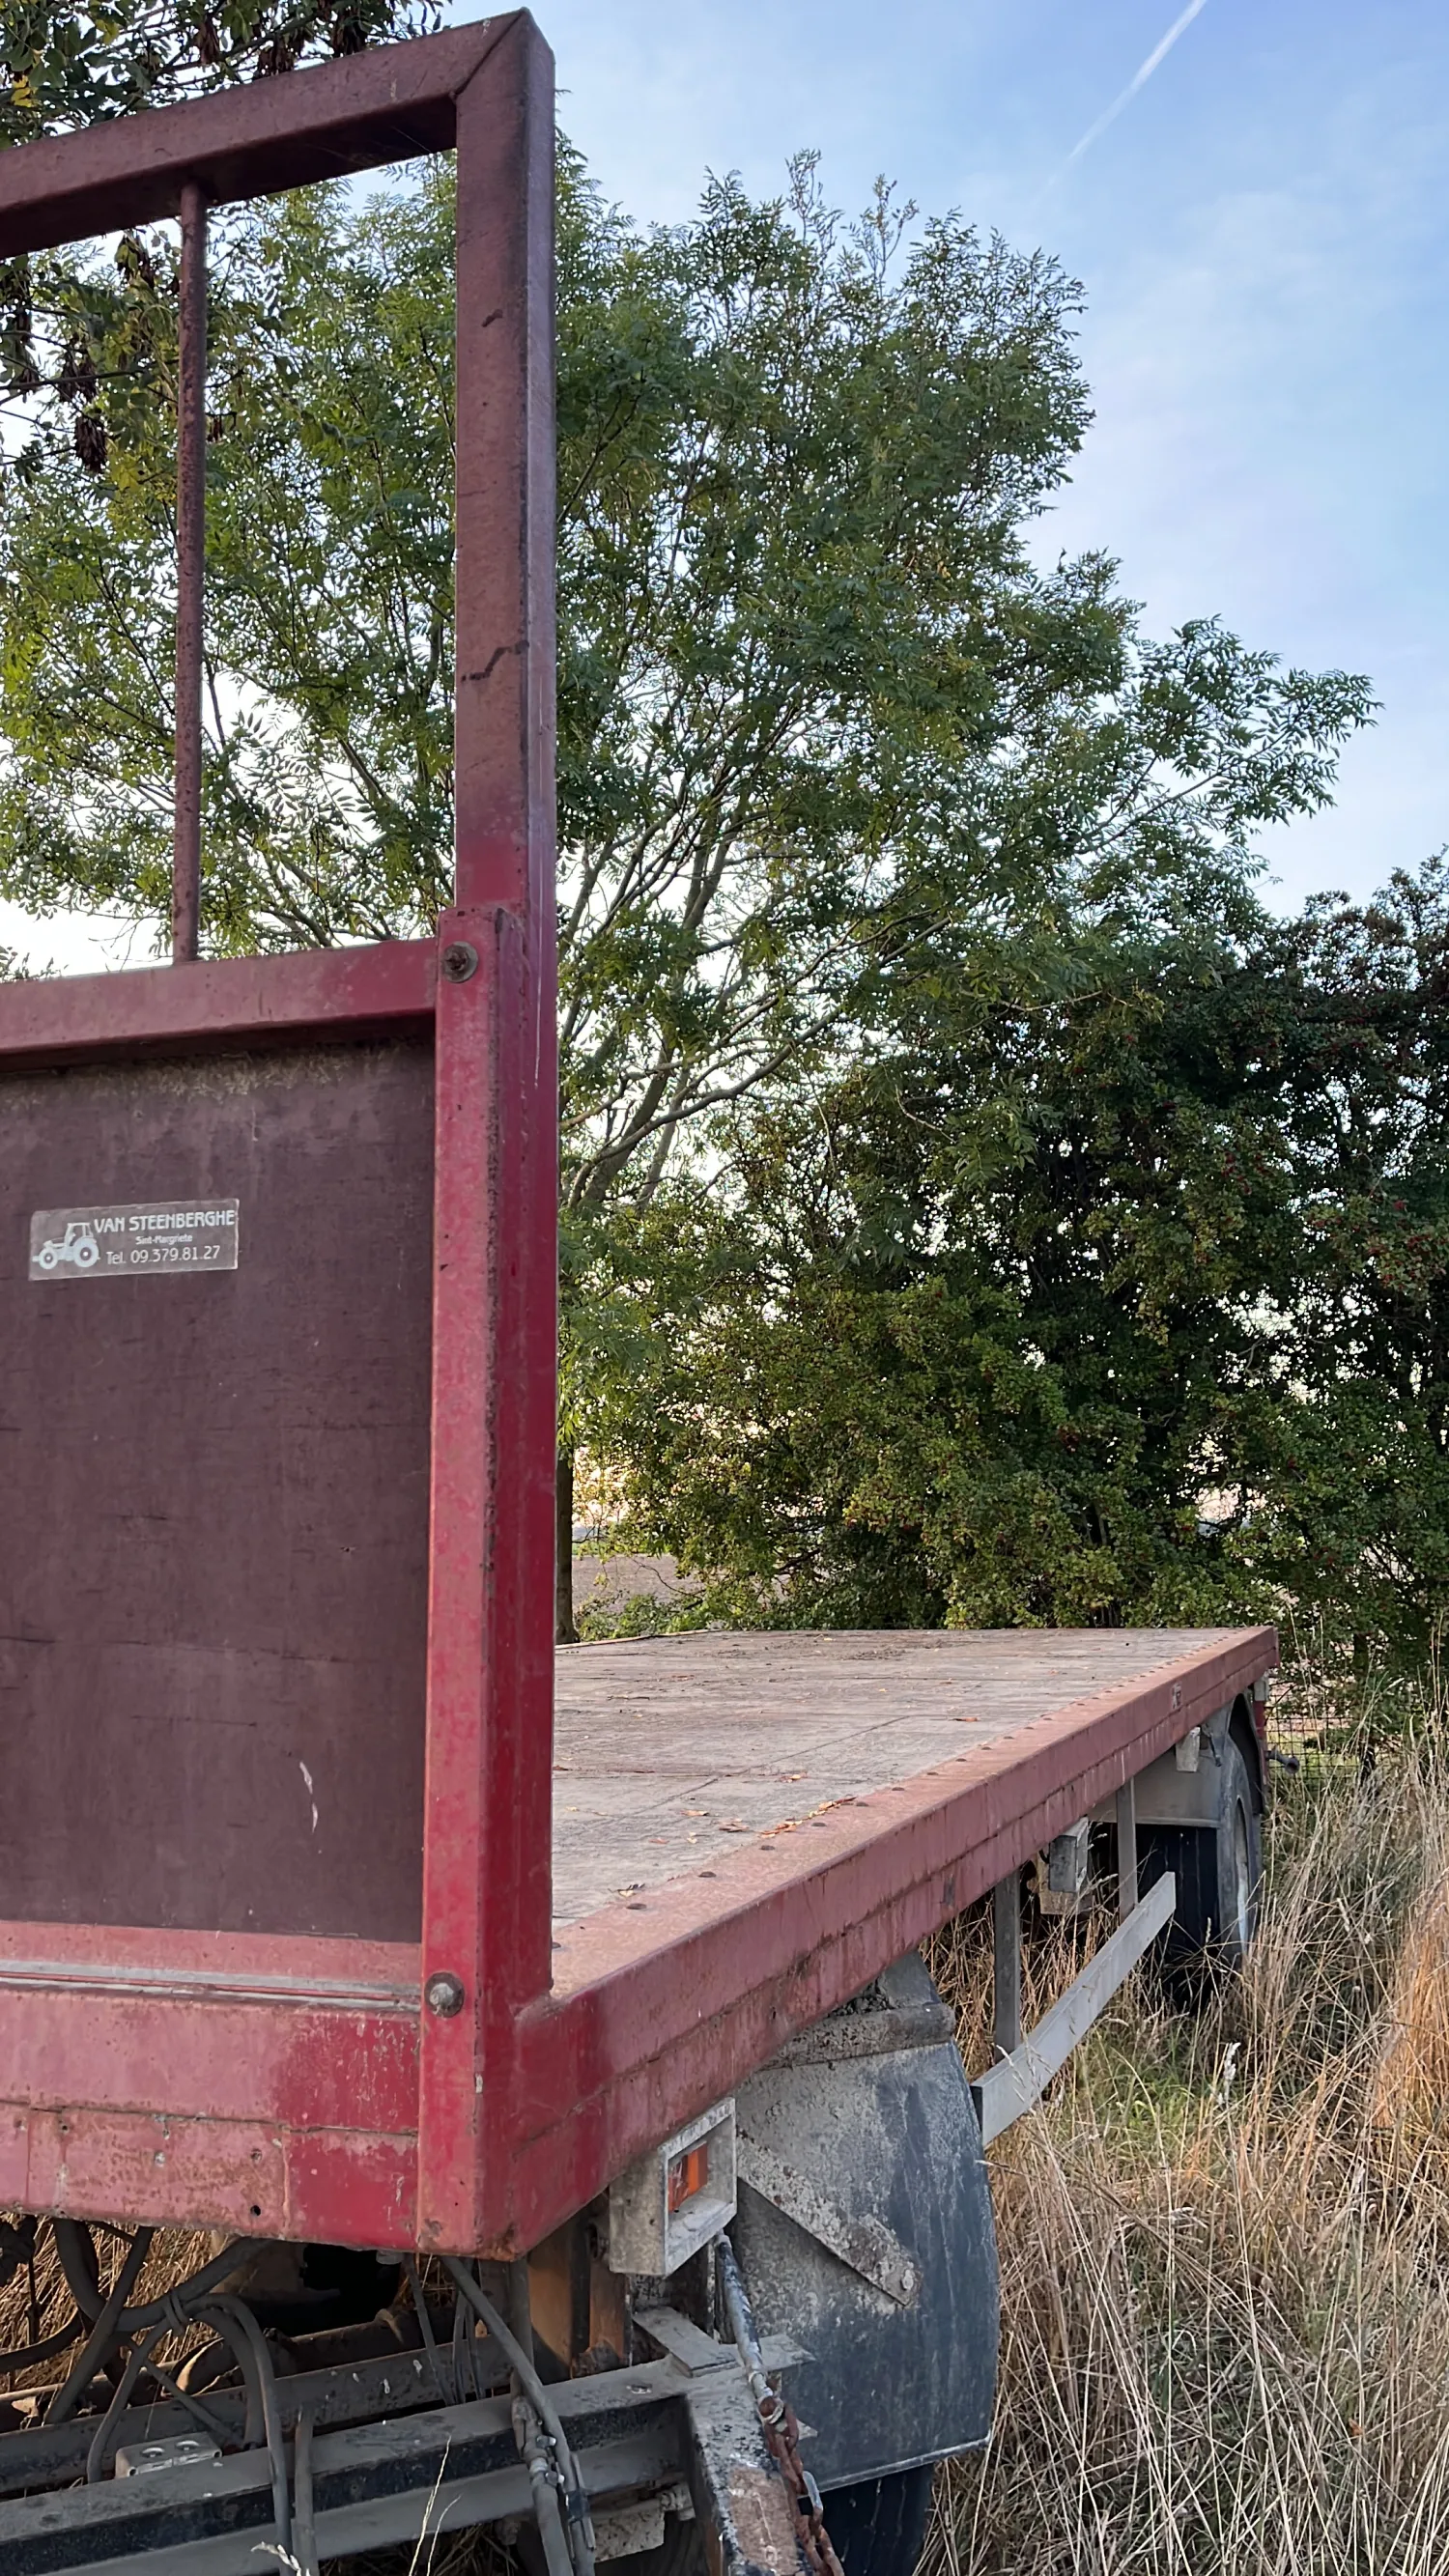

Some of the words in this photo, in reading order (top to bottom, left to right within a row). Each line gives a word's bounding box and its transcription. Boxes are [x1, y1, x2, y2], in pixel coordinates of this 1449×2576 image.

[94, 1217, 125, 1233] VAN
[128, 1209, 235, 1231] STEENBERGHE
[135, 1233, 193, 1245] Sint-Margriete
[106, 1251, 126, 1264] Tel.
[130, 1245, 221, 1263] 09.379.81.27
